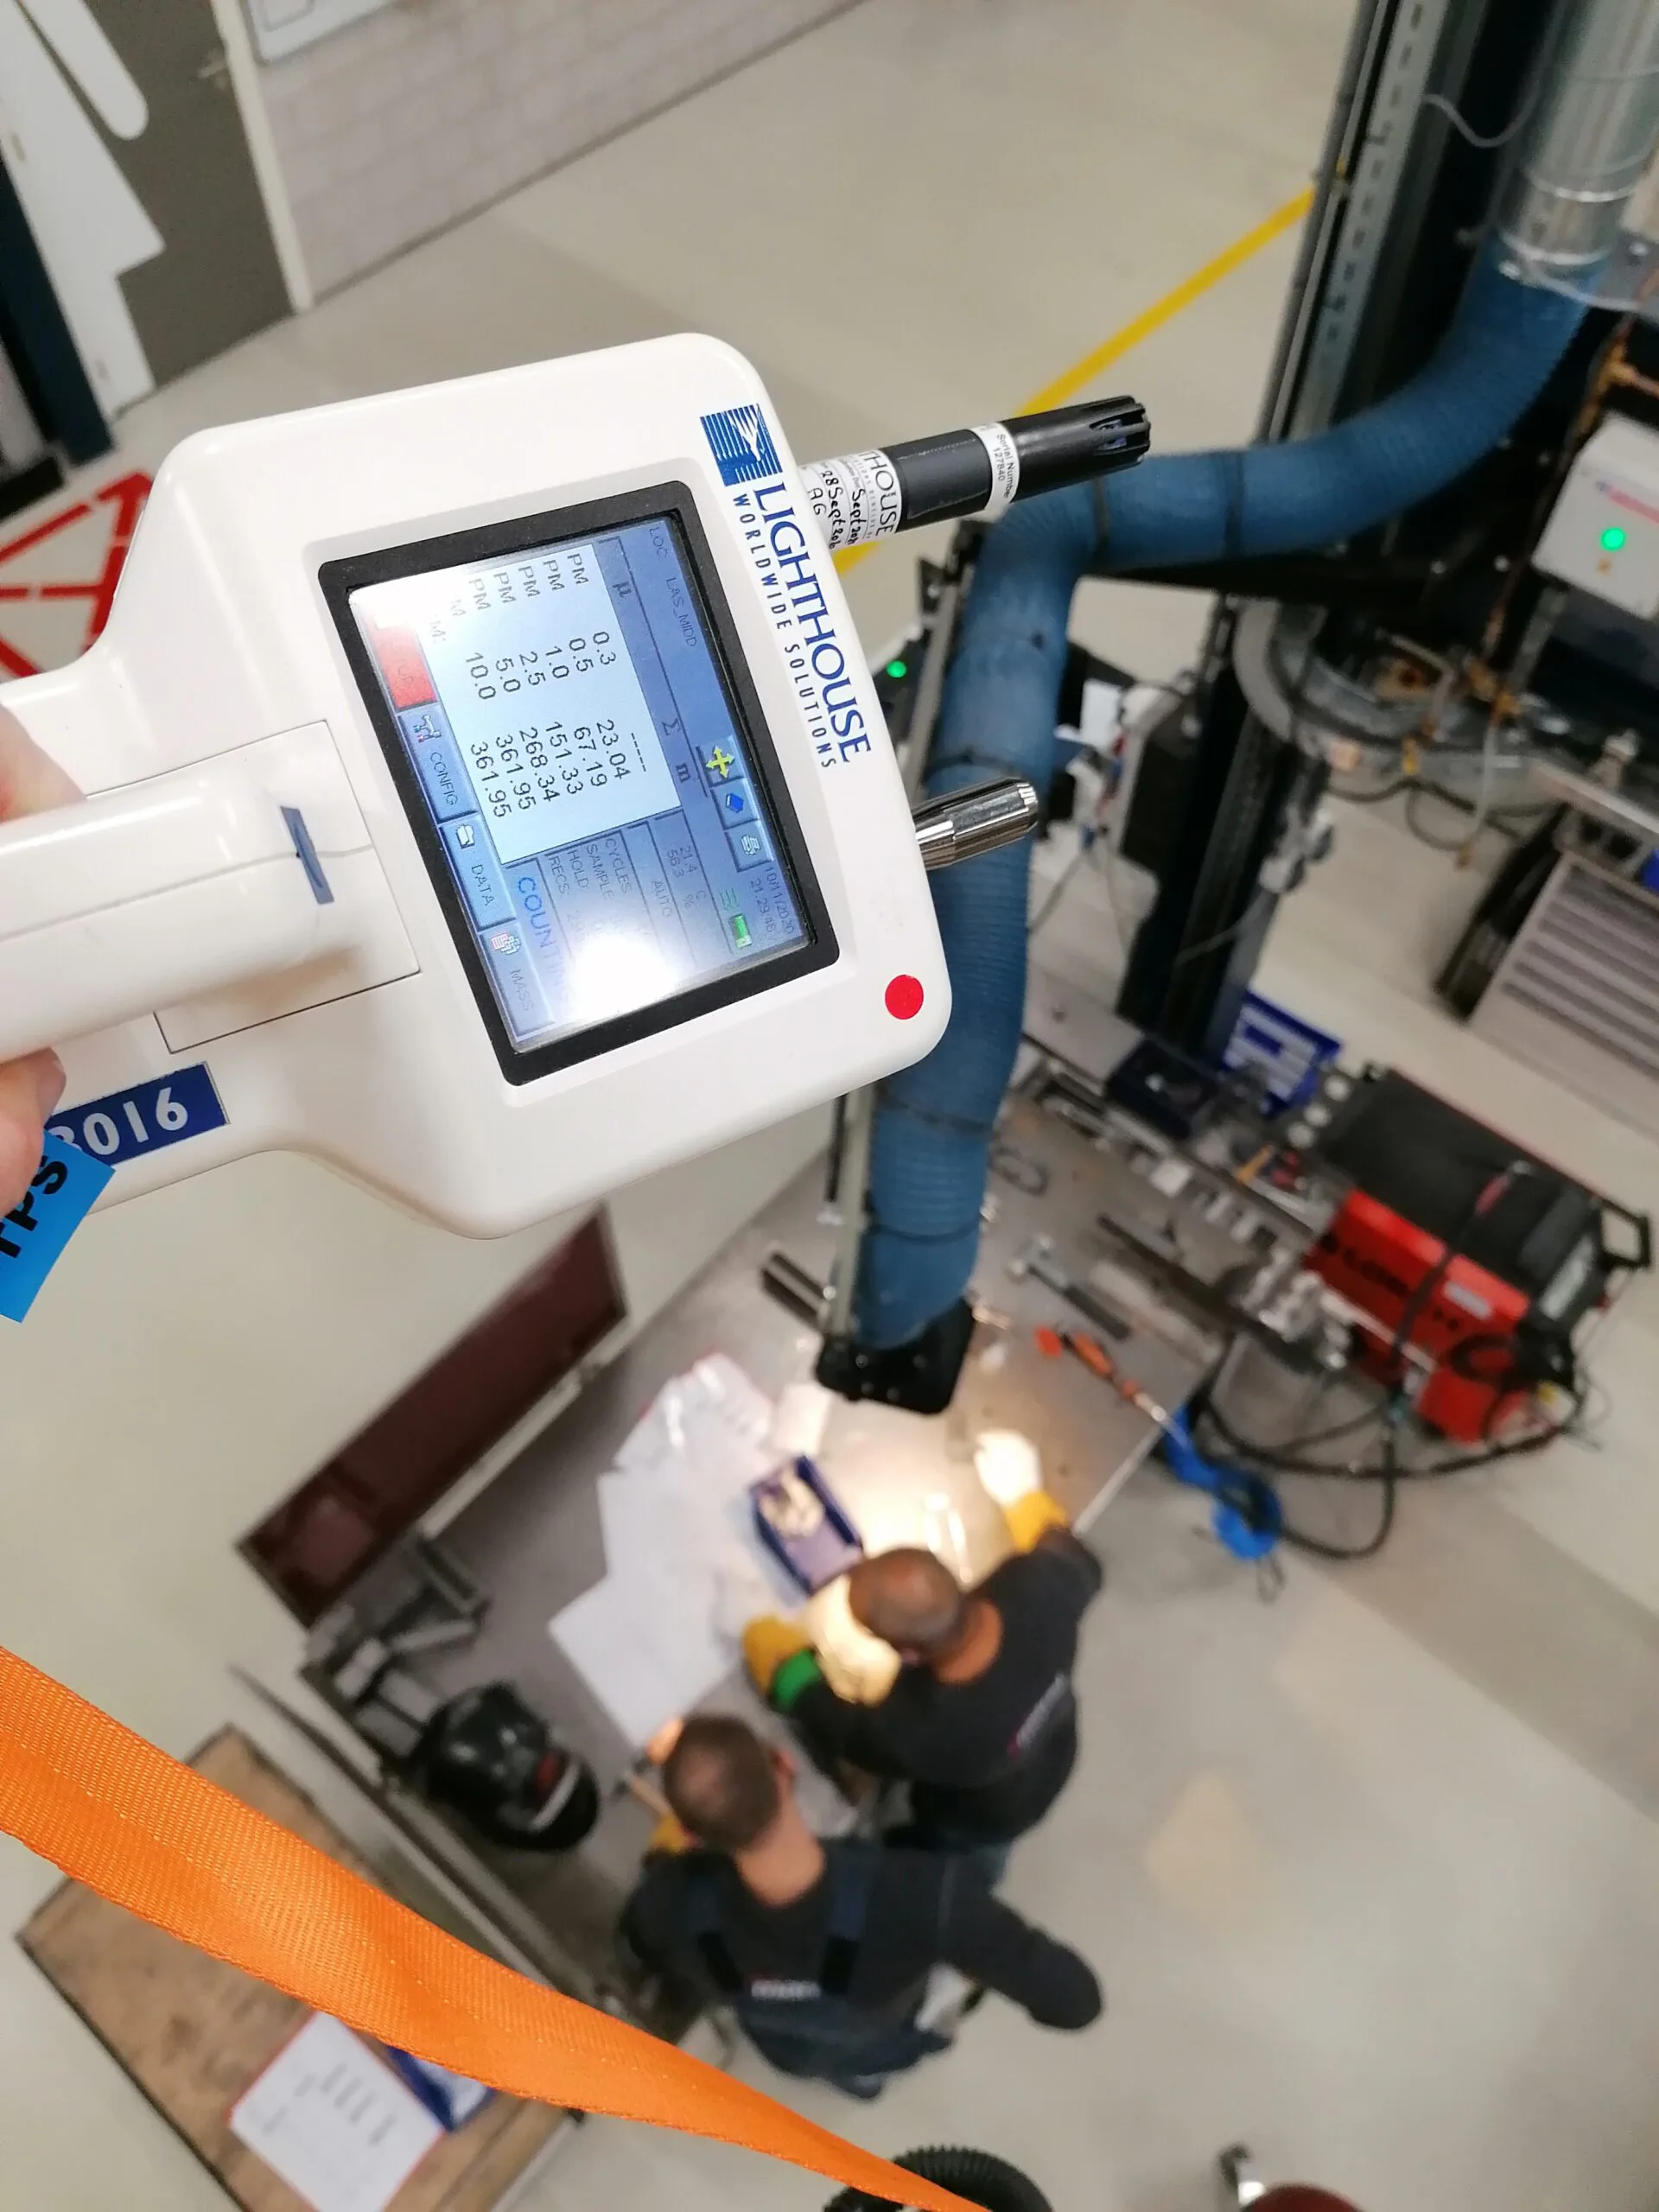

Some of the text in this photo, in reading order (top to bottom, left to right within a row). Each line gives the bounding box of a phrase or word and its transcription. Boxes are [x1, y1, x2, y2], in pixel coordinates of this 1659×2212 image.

[828, 487, 846, 526] Sept
[850, 489, 867, 526] Sept
[567, 553, 588, 584] PM
[593, 632, 616, 664] 0.3
[733, 493, 836, 767] WORLDWIDE SOLUTIONS
[753, 482, 871, 762] LIGHTHOUSE
[469, 578, 560, 802] PM 5.0 268.34
[493, 572, 583, 794] PM 2.5 151.33
[518, 566, 607, 786] PM 1.0 67.19
[543, 560, 631, 779] PM 0.5 23.04
[428, 751, 459, 806] CONFIG
[467, 653, 496, 699] 10.0
[496, 735, 536, 810] 361.95
[471, 742, 512, 817] 361.95
[471, 864, 496, 906] DATA
[679, 844, 699, 874] 21.4
[510, 969, 534, 1011] MASS
